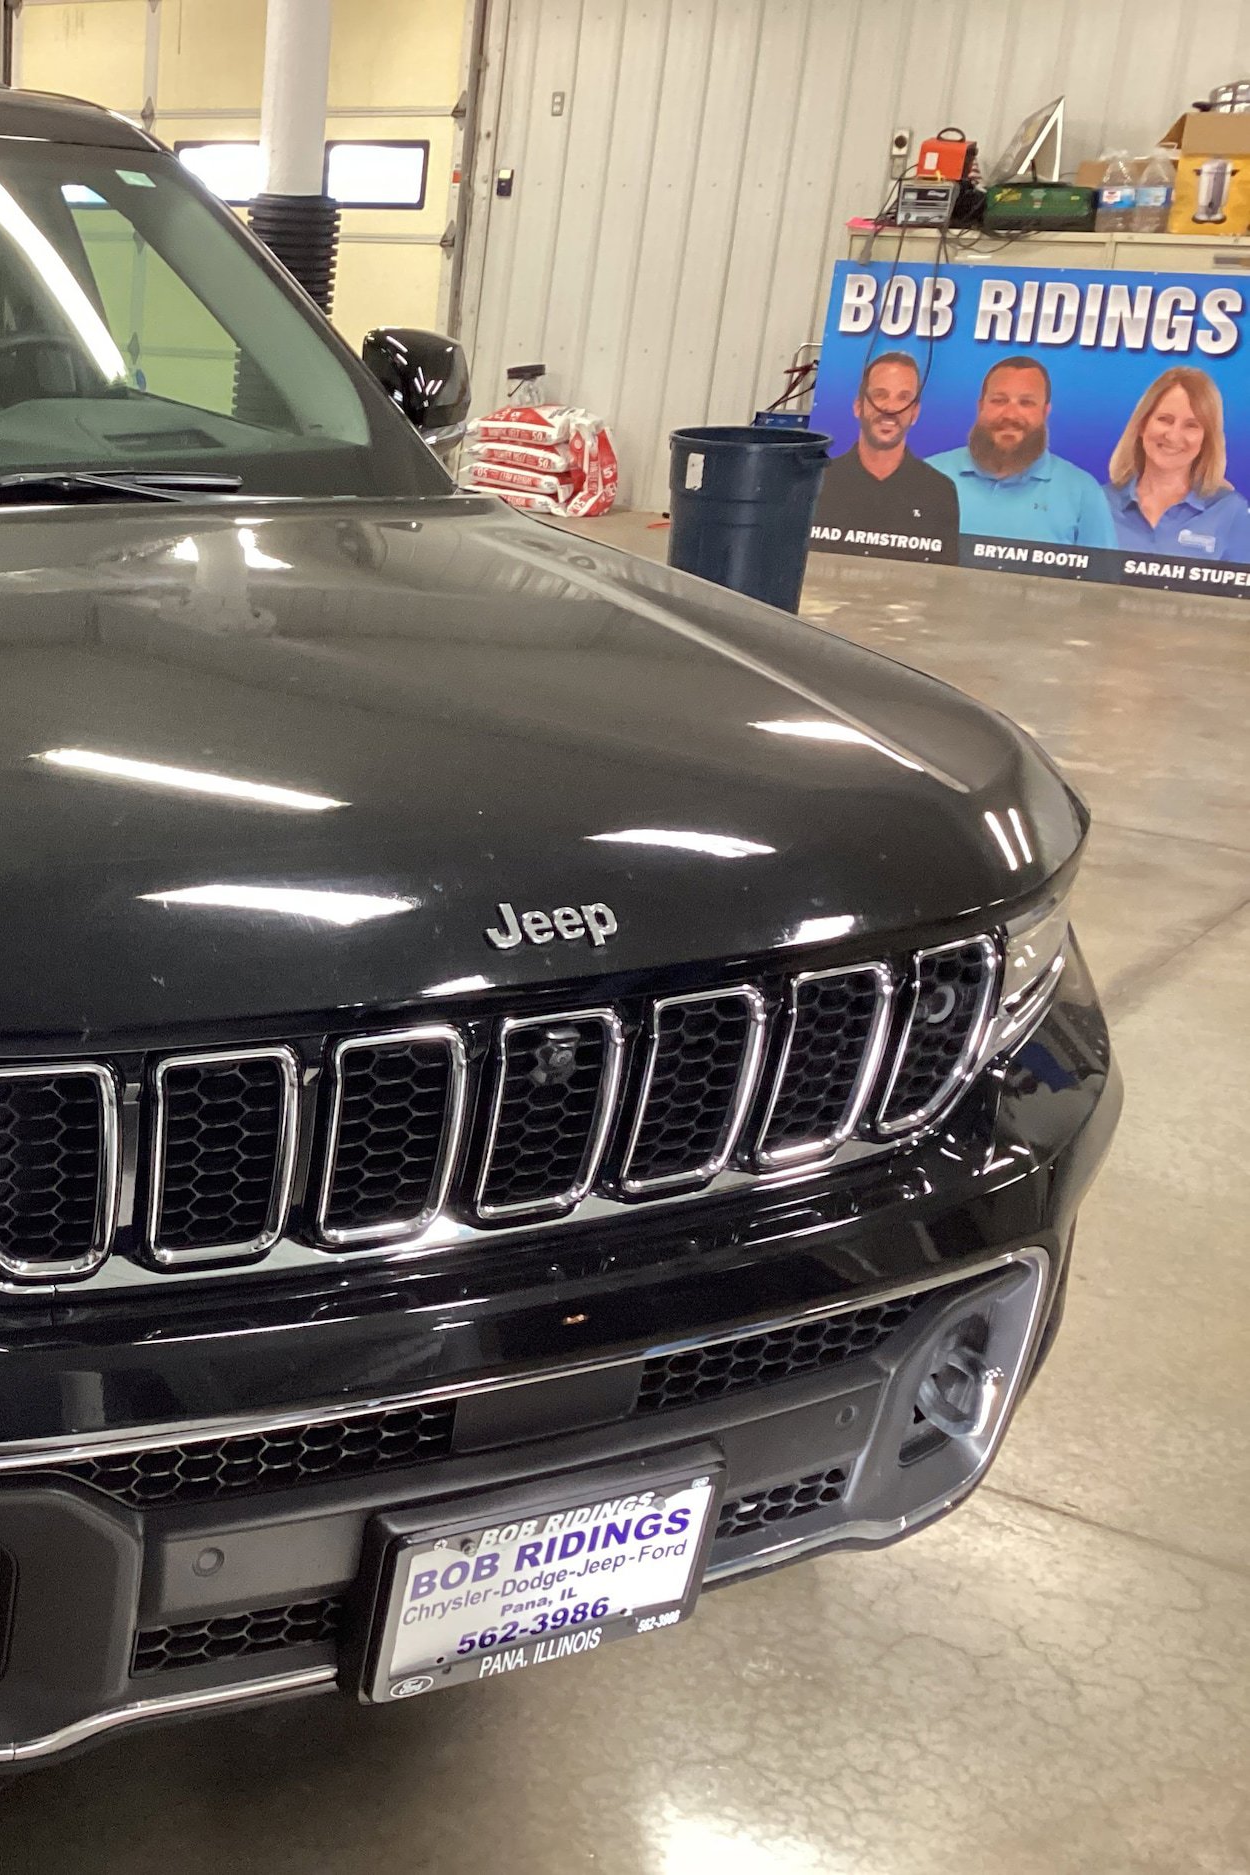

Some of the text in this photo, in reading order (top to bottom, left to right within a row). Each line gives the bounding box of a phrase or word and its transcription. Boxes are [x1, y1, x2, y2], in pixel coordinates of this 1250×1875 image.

[838, 273, 1242, 355] BOB RIDINGS
[811, 525, 943, 552] HAD ARMSTRONG
[974, 543, 1089, 569] BRYAN BOOTH
[1124, 560, 1250, 586] SARAH STUPE
[486, 902, 618, 949] Jeep
[478, 1491, 655, 1550] BOB RIDINGS
[409, 1508, 691, 1602] BOB RIDINGS
[402, 1540, 687, 1626] Chrysler-Dodge-Jeep-Ford
[560, 1586, 578, 1601] IL
[456, 1597, 610, 1655] 562-3986
[533, 1628, 602, 1666] ILLINOIS
